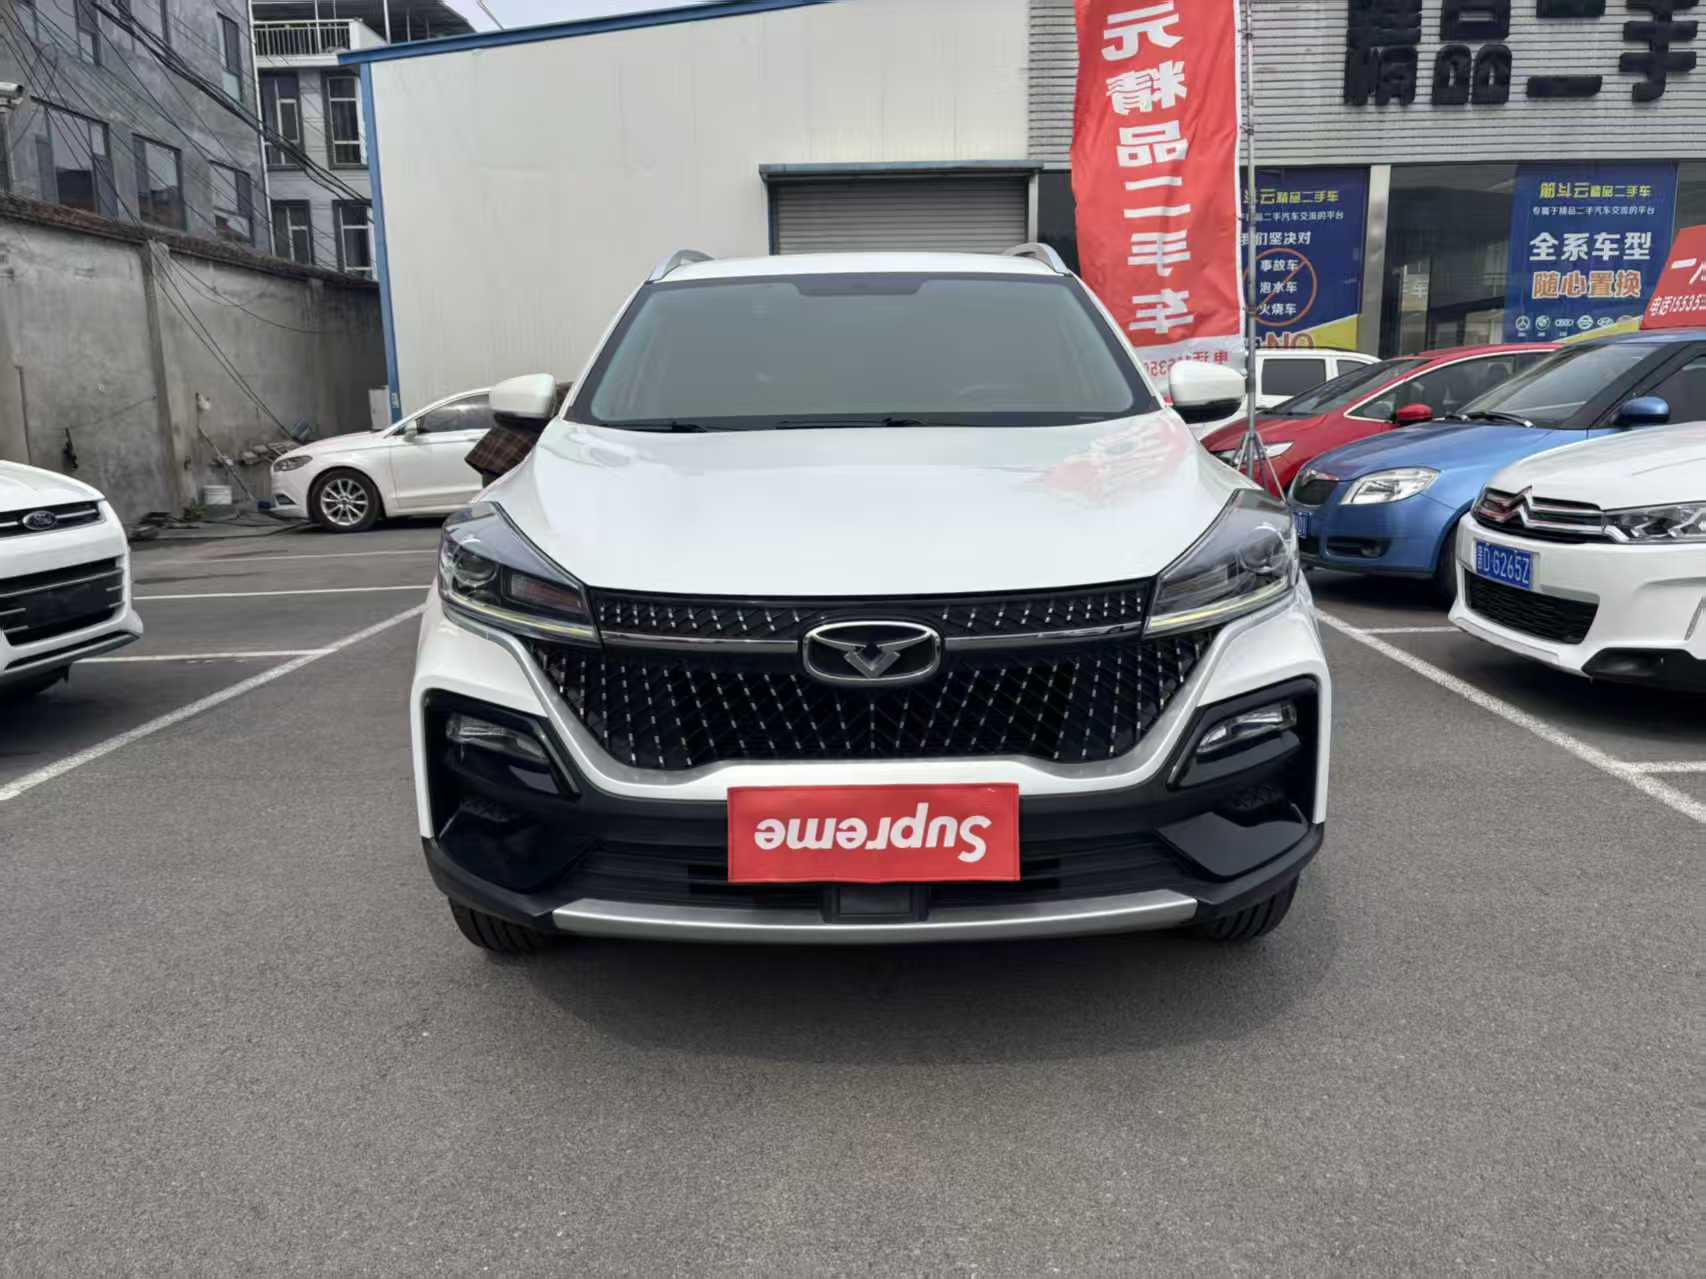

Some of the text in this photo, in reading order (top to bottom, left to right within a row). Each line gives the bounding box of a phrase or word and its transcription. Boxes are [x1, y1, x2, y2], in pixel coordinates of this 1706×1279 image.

[1529, 231, 1652, 261] 全系车型
[1260, 259, 1299, 272] 事故车
[1532, 270, 1642, 299] 随心置换
[1258, 302, 1297, 316] 火烧车
[753, 802, 993, 864] Supreme
